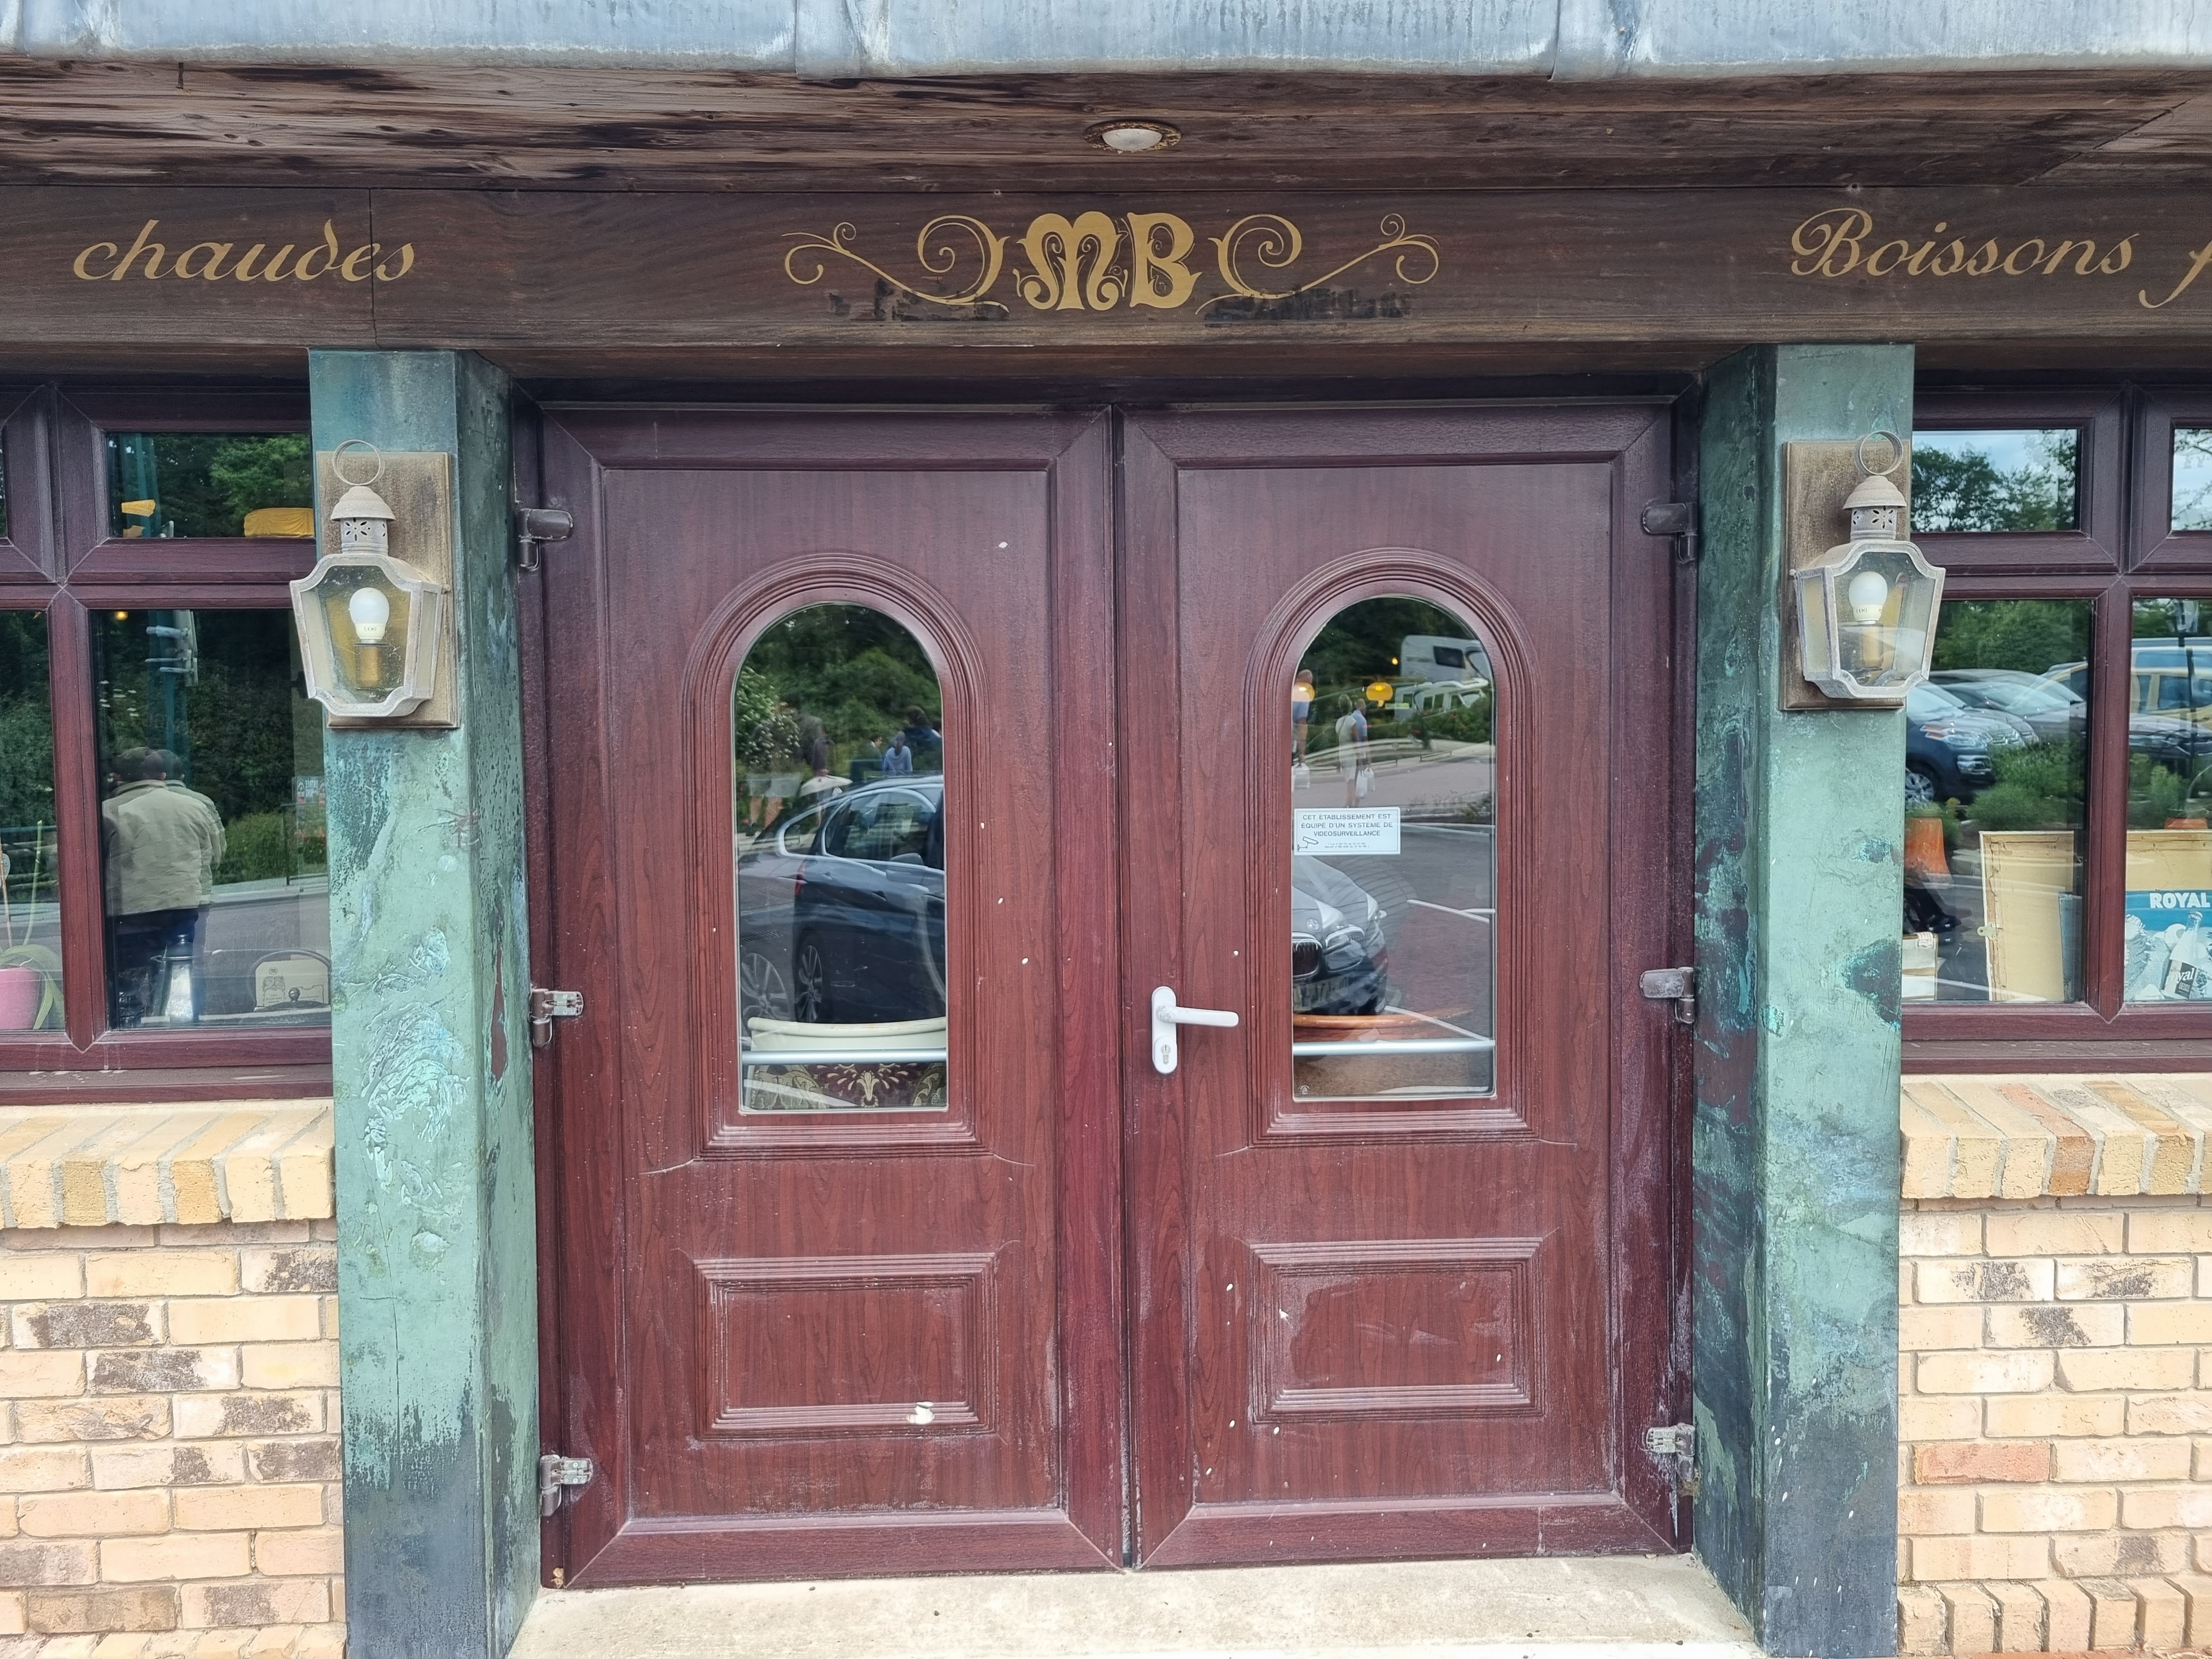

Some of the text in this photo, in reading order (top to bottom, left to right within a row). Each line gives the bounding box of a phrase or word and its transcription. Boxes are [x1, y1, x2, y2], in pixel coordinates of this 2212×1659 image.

[73, 219, 415, 281] chaudes
[1014, 211, 1203, 311] MB
[1791, 208, 2140, 278] Boissons
[2149, 892, 2211, 909] ROYAL
